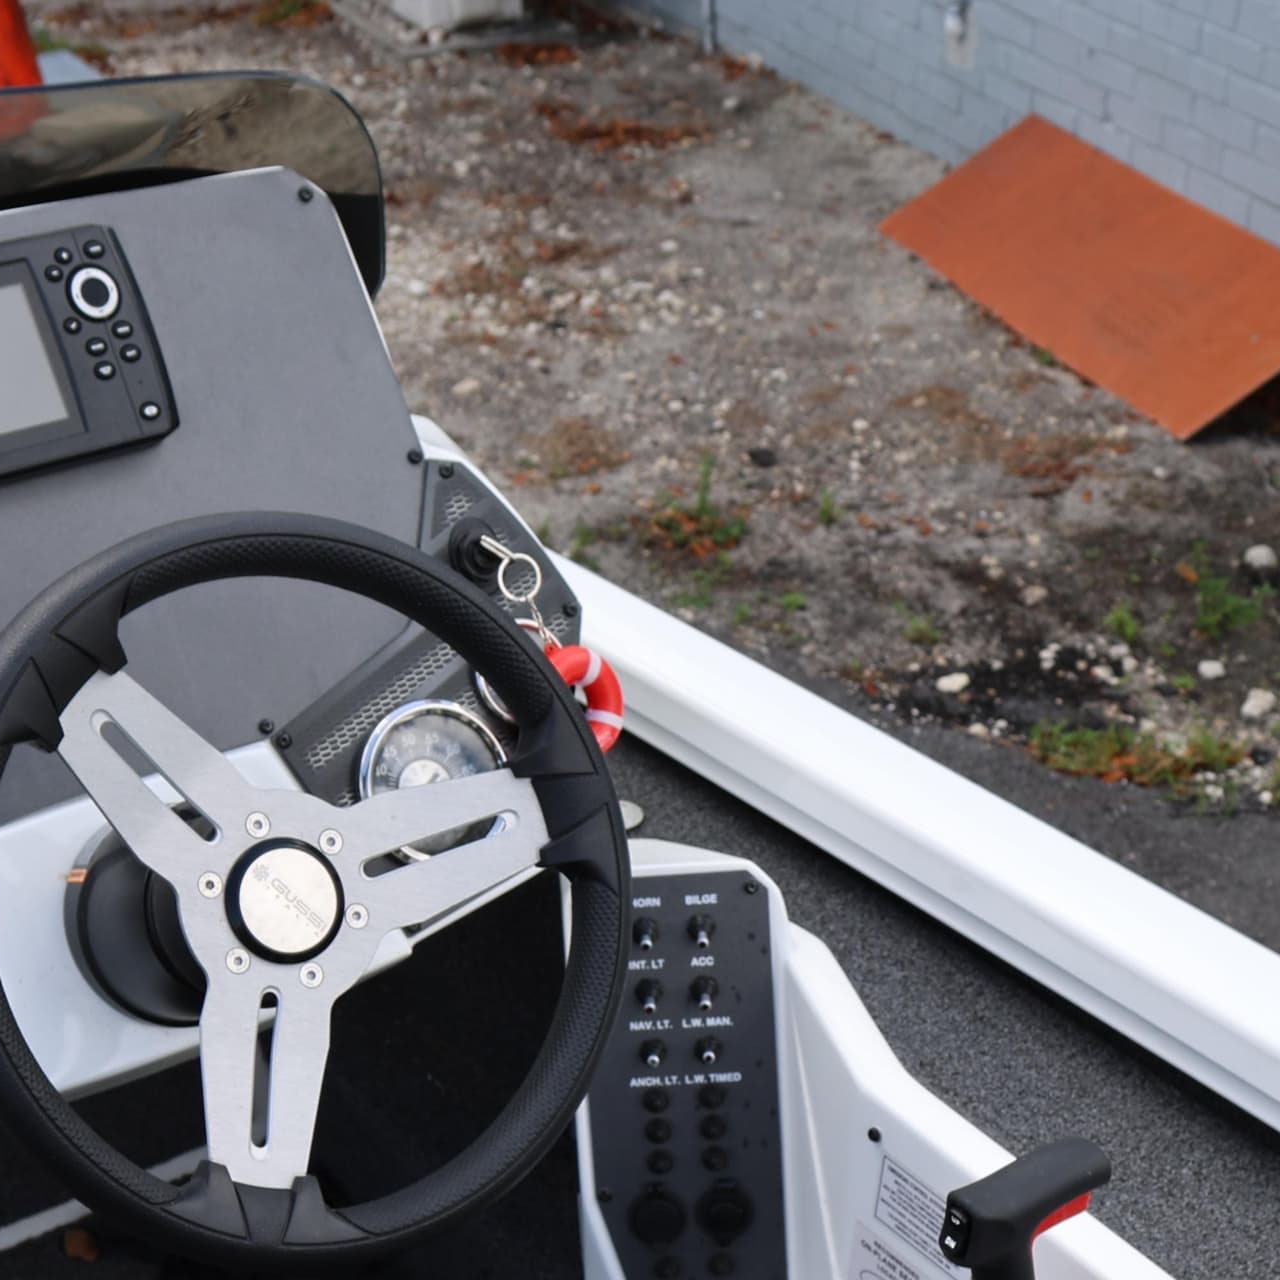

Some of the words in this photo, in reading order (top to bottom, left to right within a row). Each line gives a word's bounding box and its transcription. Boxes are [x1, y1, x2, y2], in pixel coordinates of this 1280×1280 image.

[684, 893, 718, 906] BILGE
[651, 958, 665, 970] LT
[690, 956, 715, 968] ACC
[629, 1020, 656, 1032] NAV.
[656, 1019, 674, 1030] LT.
[663, 1075, 681, 1086] LT.
[708, 1071, 742, 1083] TIMED
